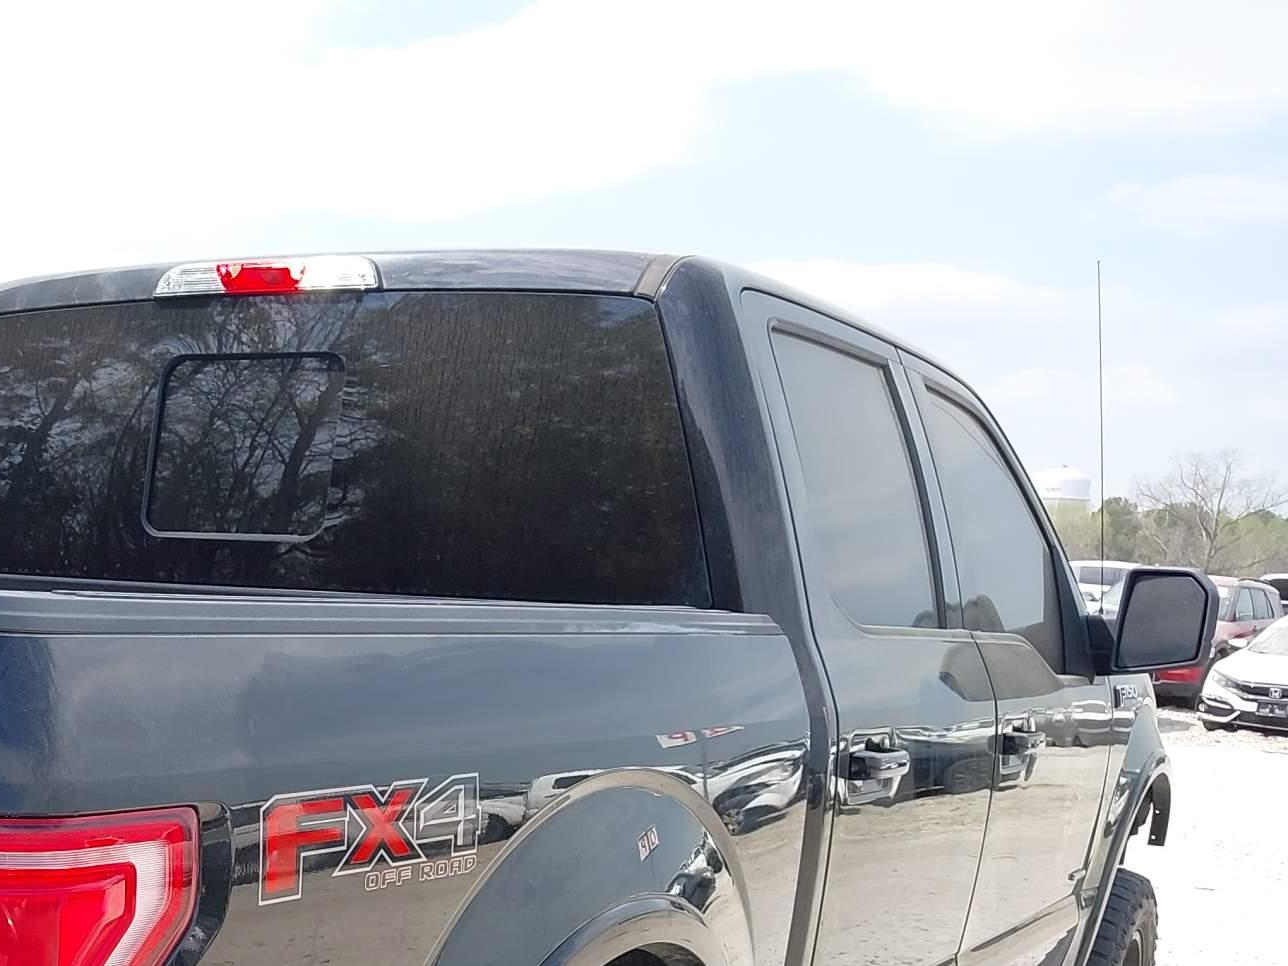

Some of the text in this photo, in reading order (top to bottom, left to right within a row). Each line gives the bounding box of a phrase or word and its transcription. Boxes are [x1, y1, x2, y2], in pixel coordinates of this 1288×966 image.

[259, 773, 481, 906] FX4
[365, 855, 478, 892] OFF ROAD
